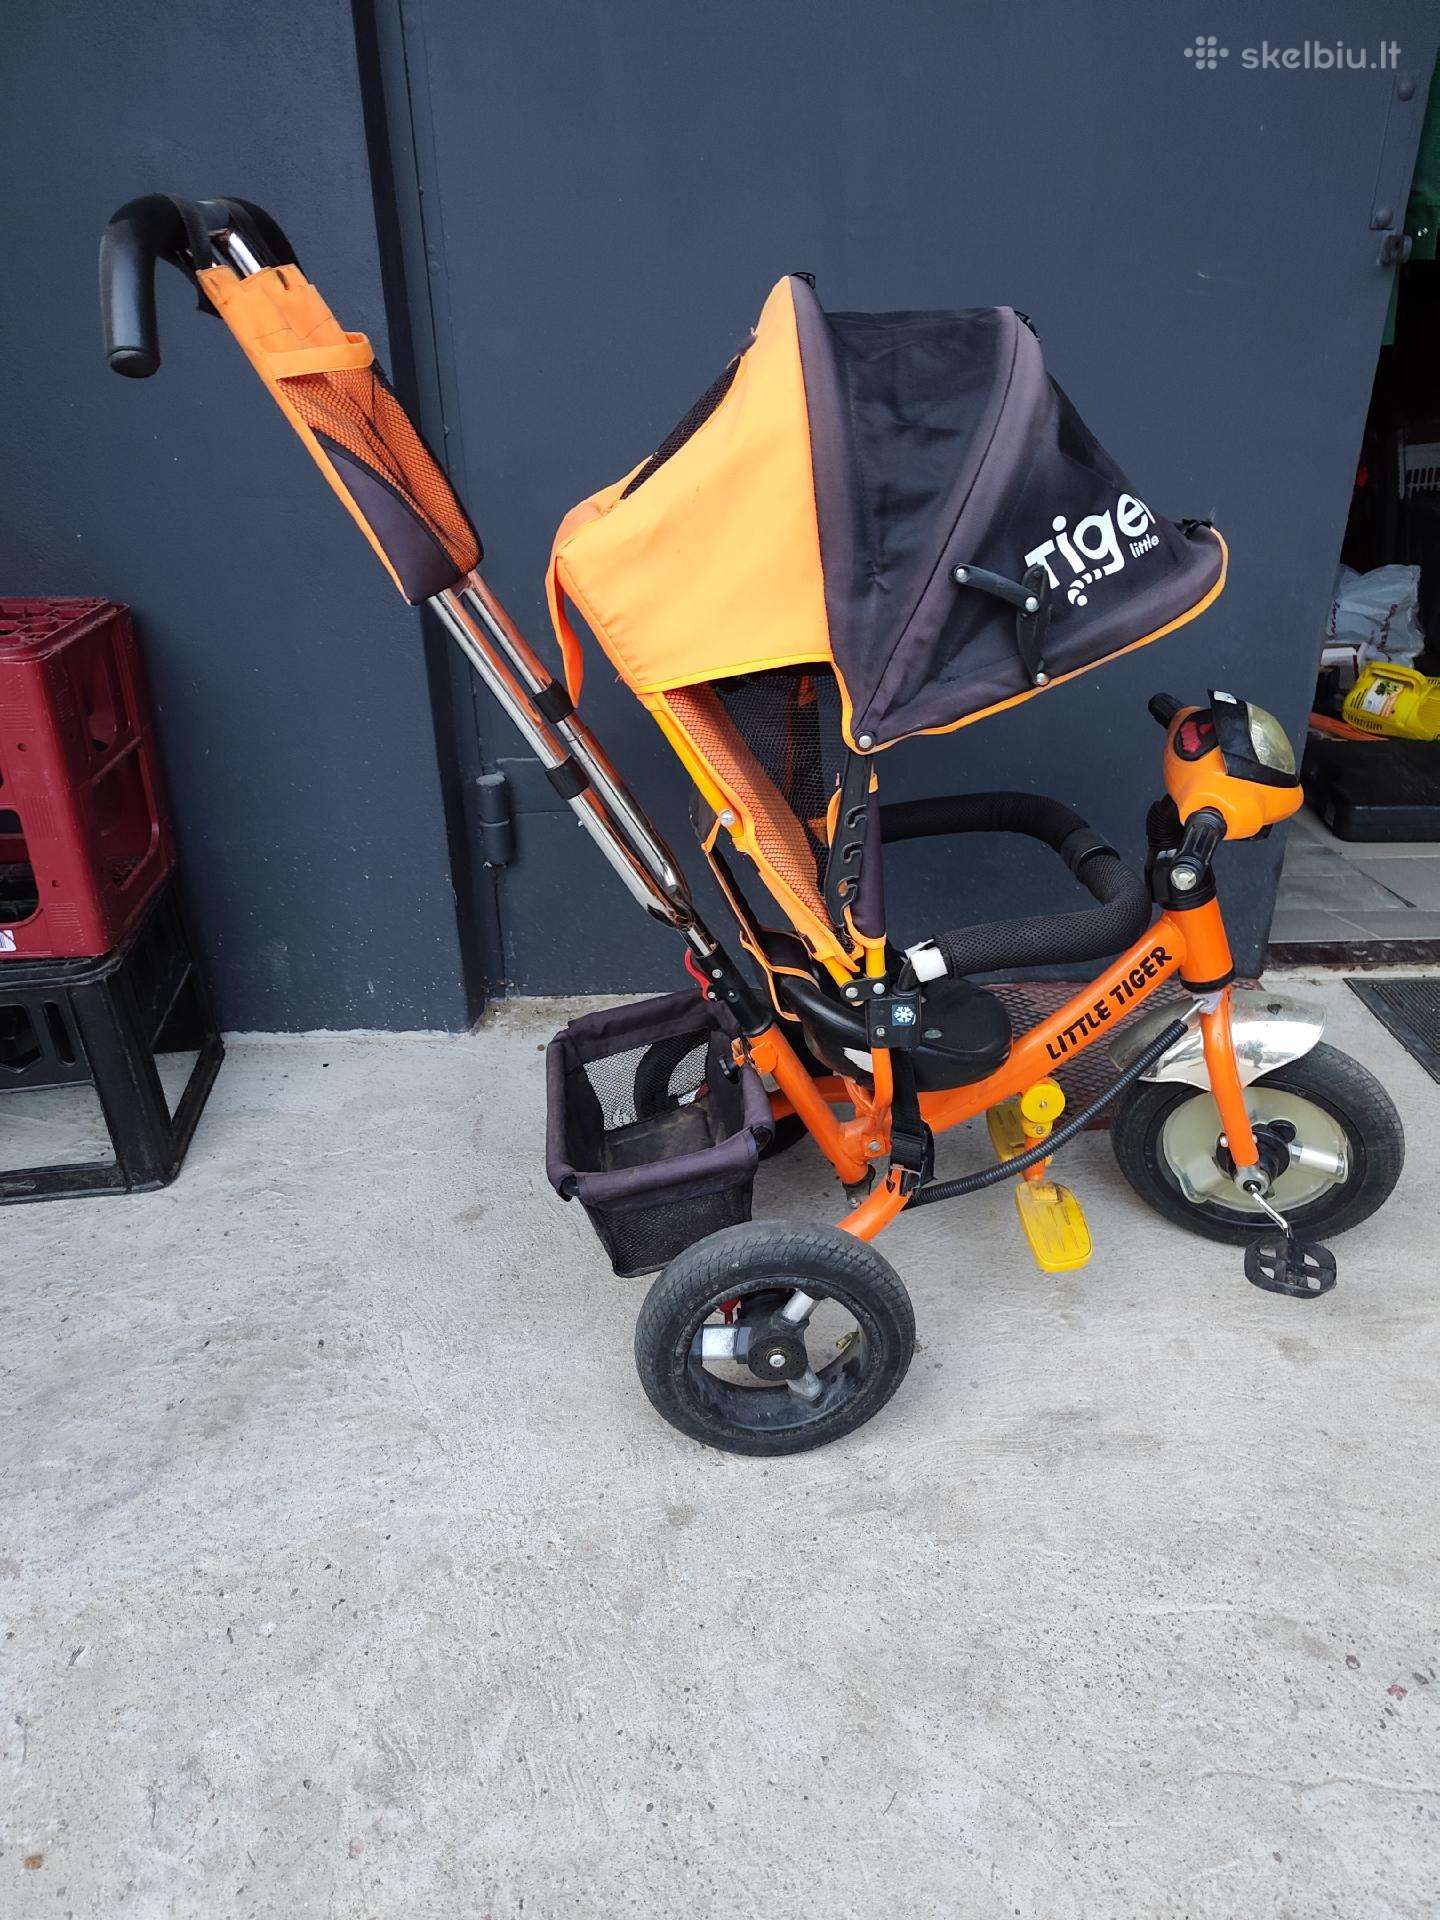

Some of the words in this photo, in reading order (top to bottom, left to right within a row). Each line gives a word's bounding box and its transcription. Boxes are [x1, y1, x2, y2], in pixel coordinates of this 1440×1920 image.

[1129, 533, 1160, 558] little
[1046, 999, 1111, 1060] LITTLE
[1109, 946, 1173, 1006] TIGER
